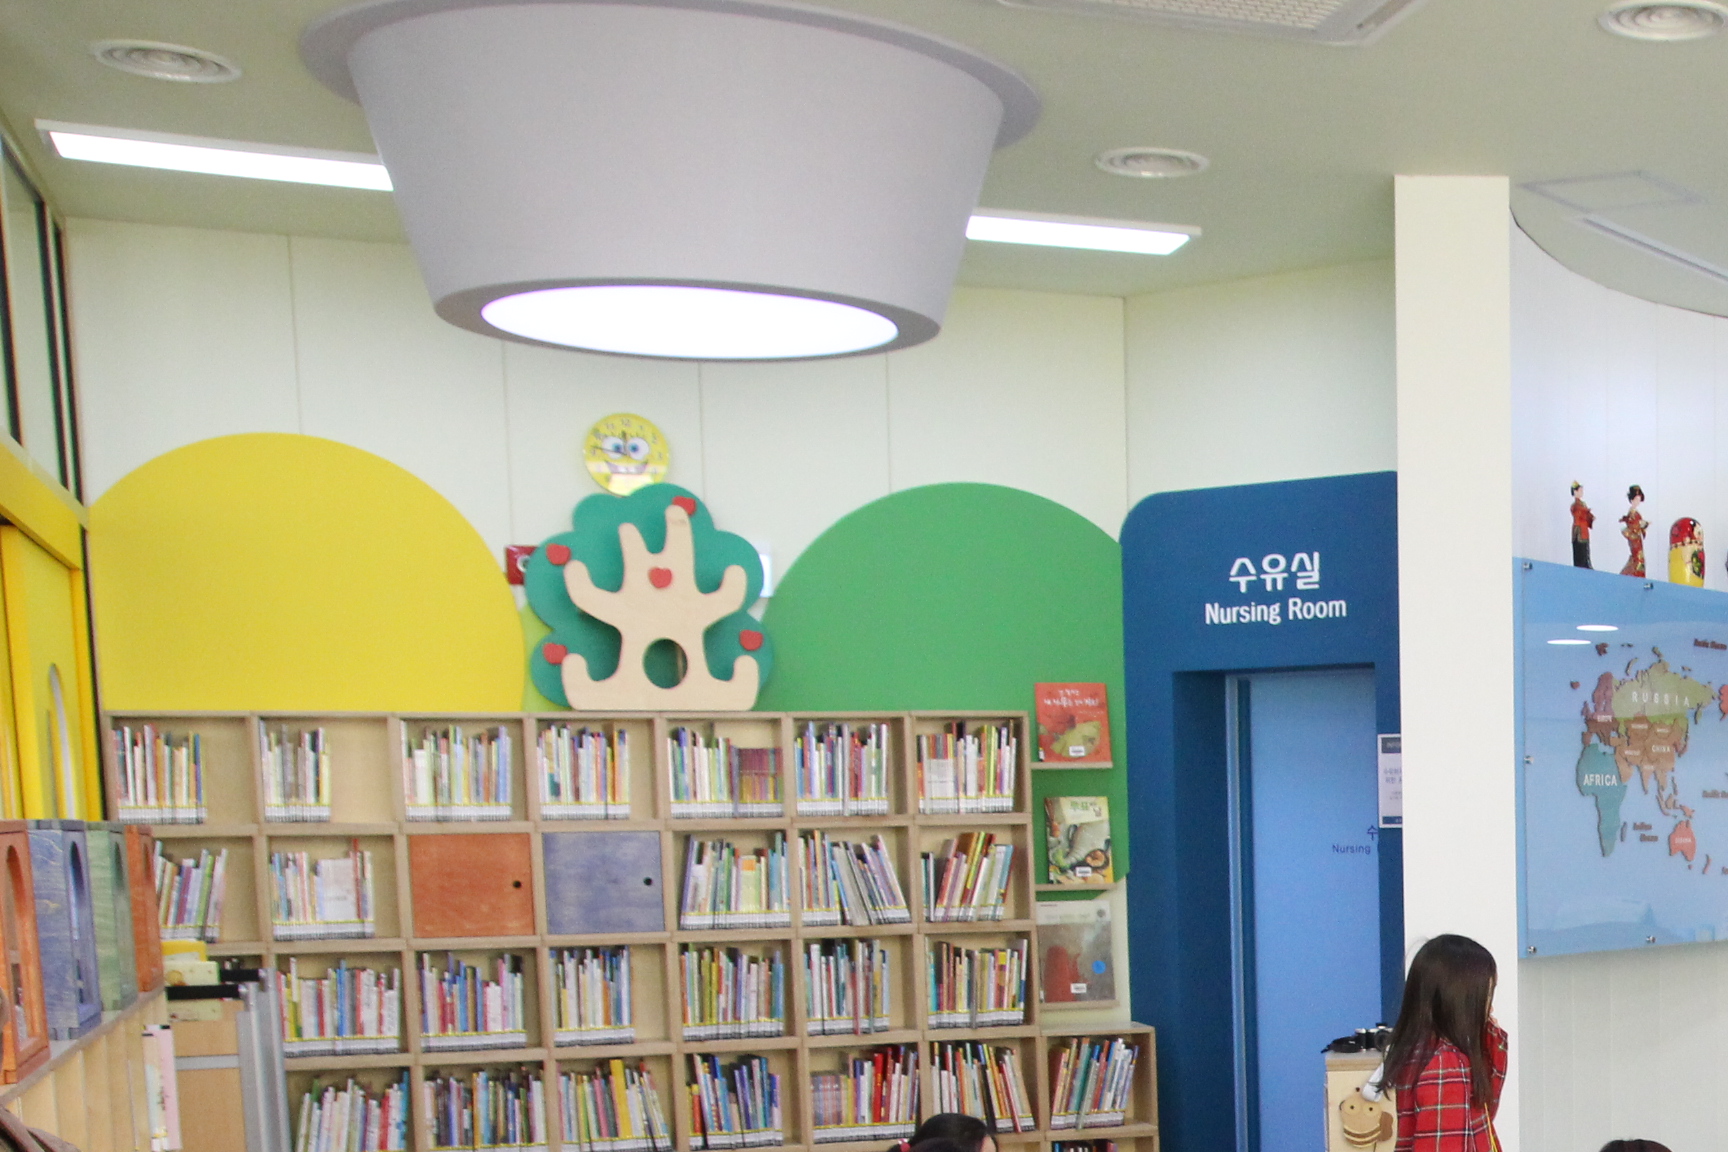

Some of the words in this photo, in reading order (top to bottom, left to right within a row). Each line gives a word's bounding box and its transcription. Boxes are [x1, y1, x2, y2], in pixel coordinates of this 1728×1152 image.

[1229, 551, 1320, 594] 수유실
[1204, 602, 1281, 625] Nursing
[1288, 597, 1347, 620] Room
[1631, 691, 1690, 707] RUSSIA
[1652, 744, 1671, 753] CHINA
[1583, 773, 1618, 787] AFRICA
[1332, 844, 1371, 855] Nursing
